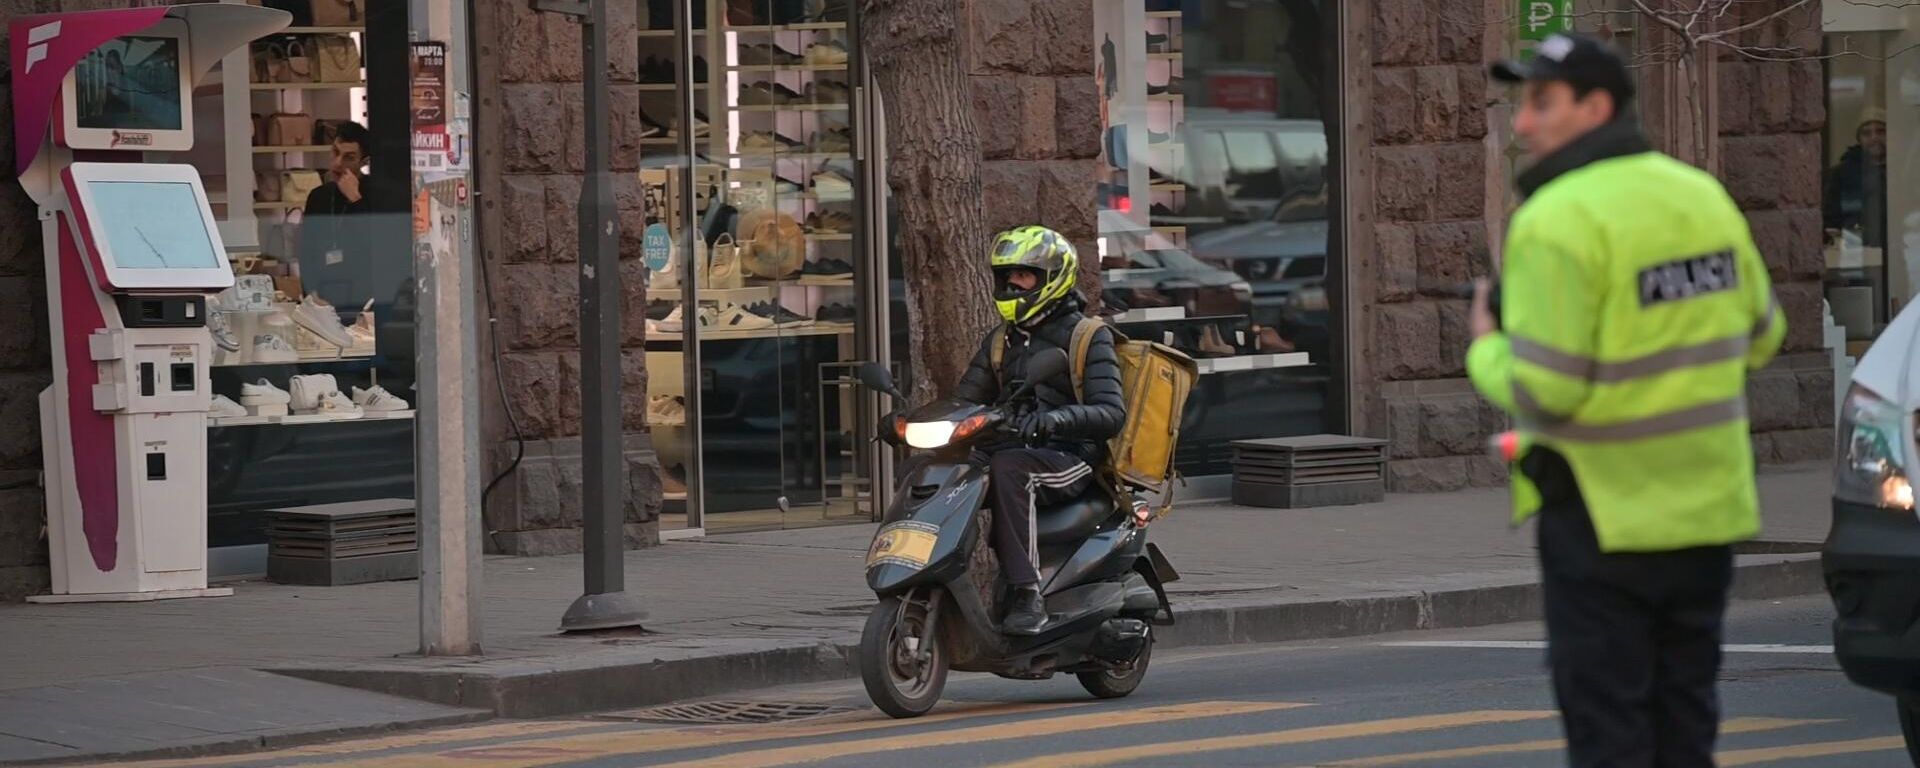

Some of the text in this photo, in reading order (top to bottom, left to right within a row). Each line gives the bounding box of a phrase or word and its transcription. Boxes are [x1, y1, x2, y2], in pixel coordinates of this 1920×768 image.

[418, 46, 443, 56] МАРТА
[647, 235, 665, 247] TAX
[645, 248, 667, 259] FREE
